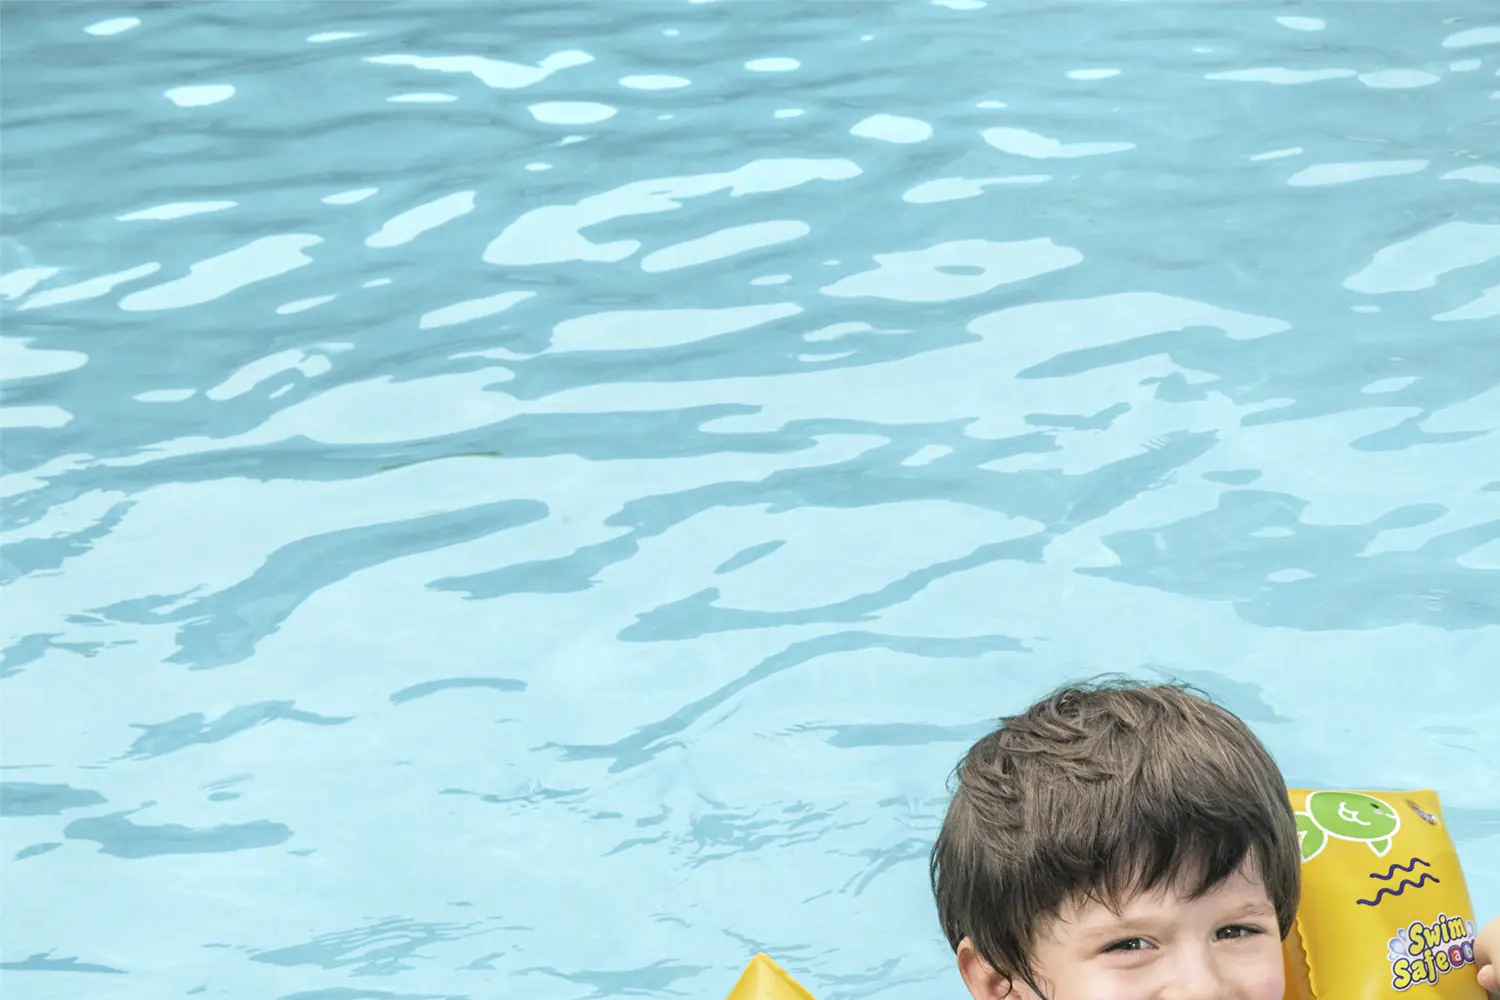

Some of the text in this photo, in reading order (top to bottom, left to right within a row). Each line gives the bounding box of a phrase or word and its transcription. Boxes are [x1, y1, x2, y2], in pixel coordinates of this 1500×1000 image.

[1408, 914, 1467, 956] Swim
[1393, 940, 1475, 990] Safe ab
